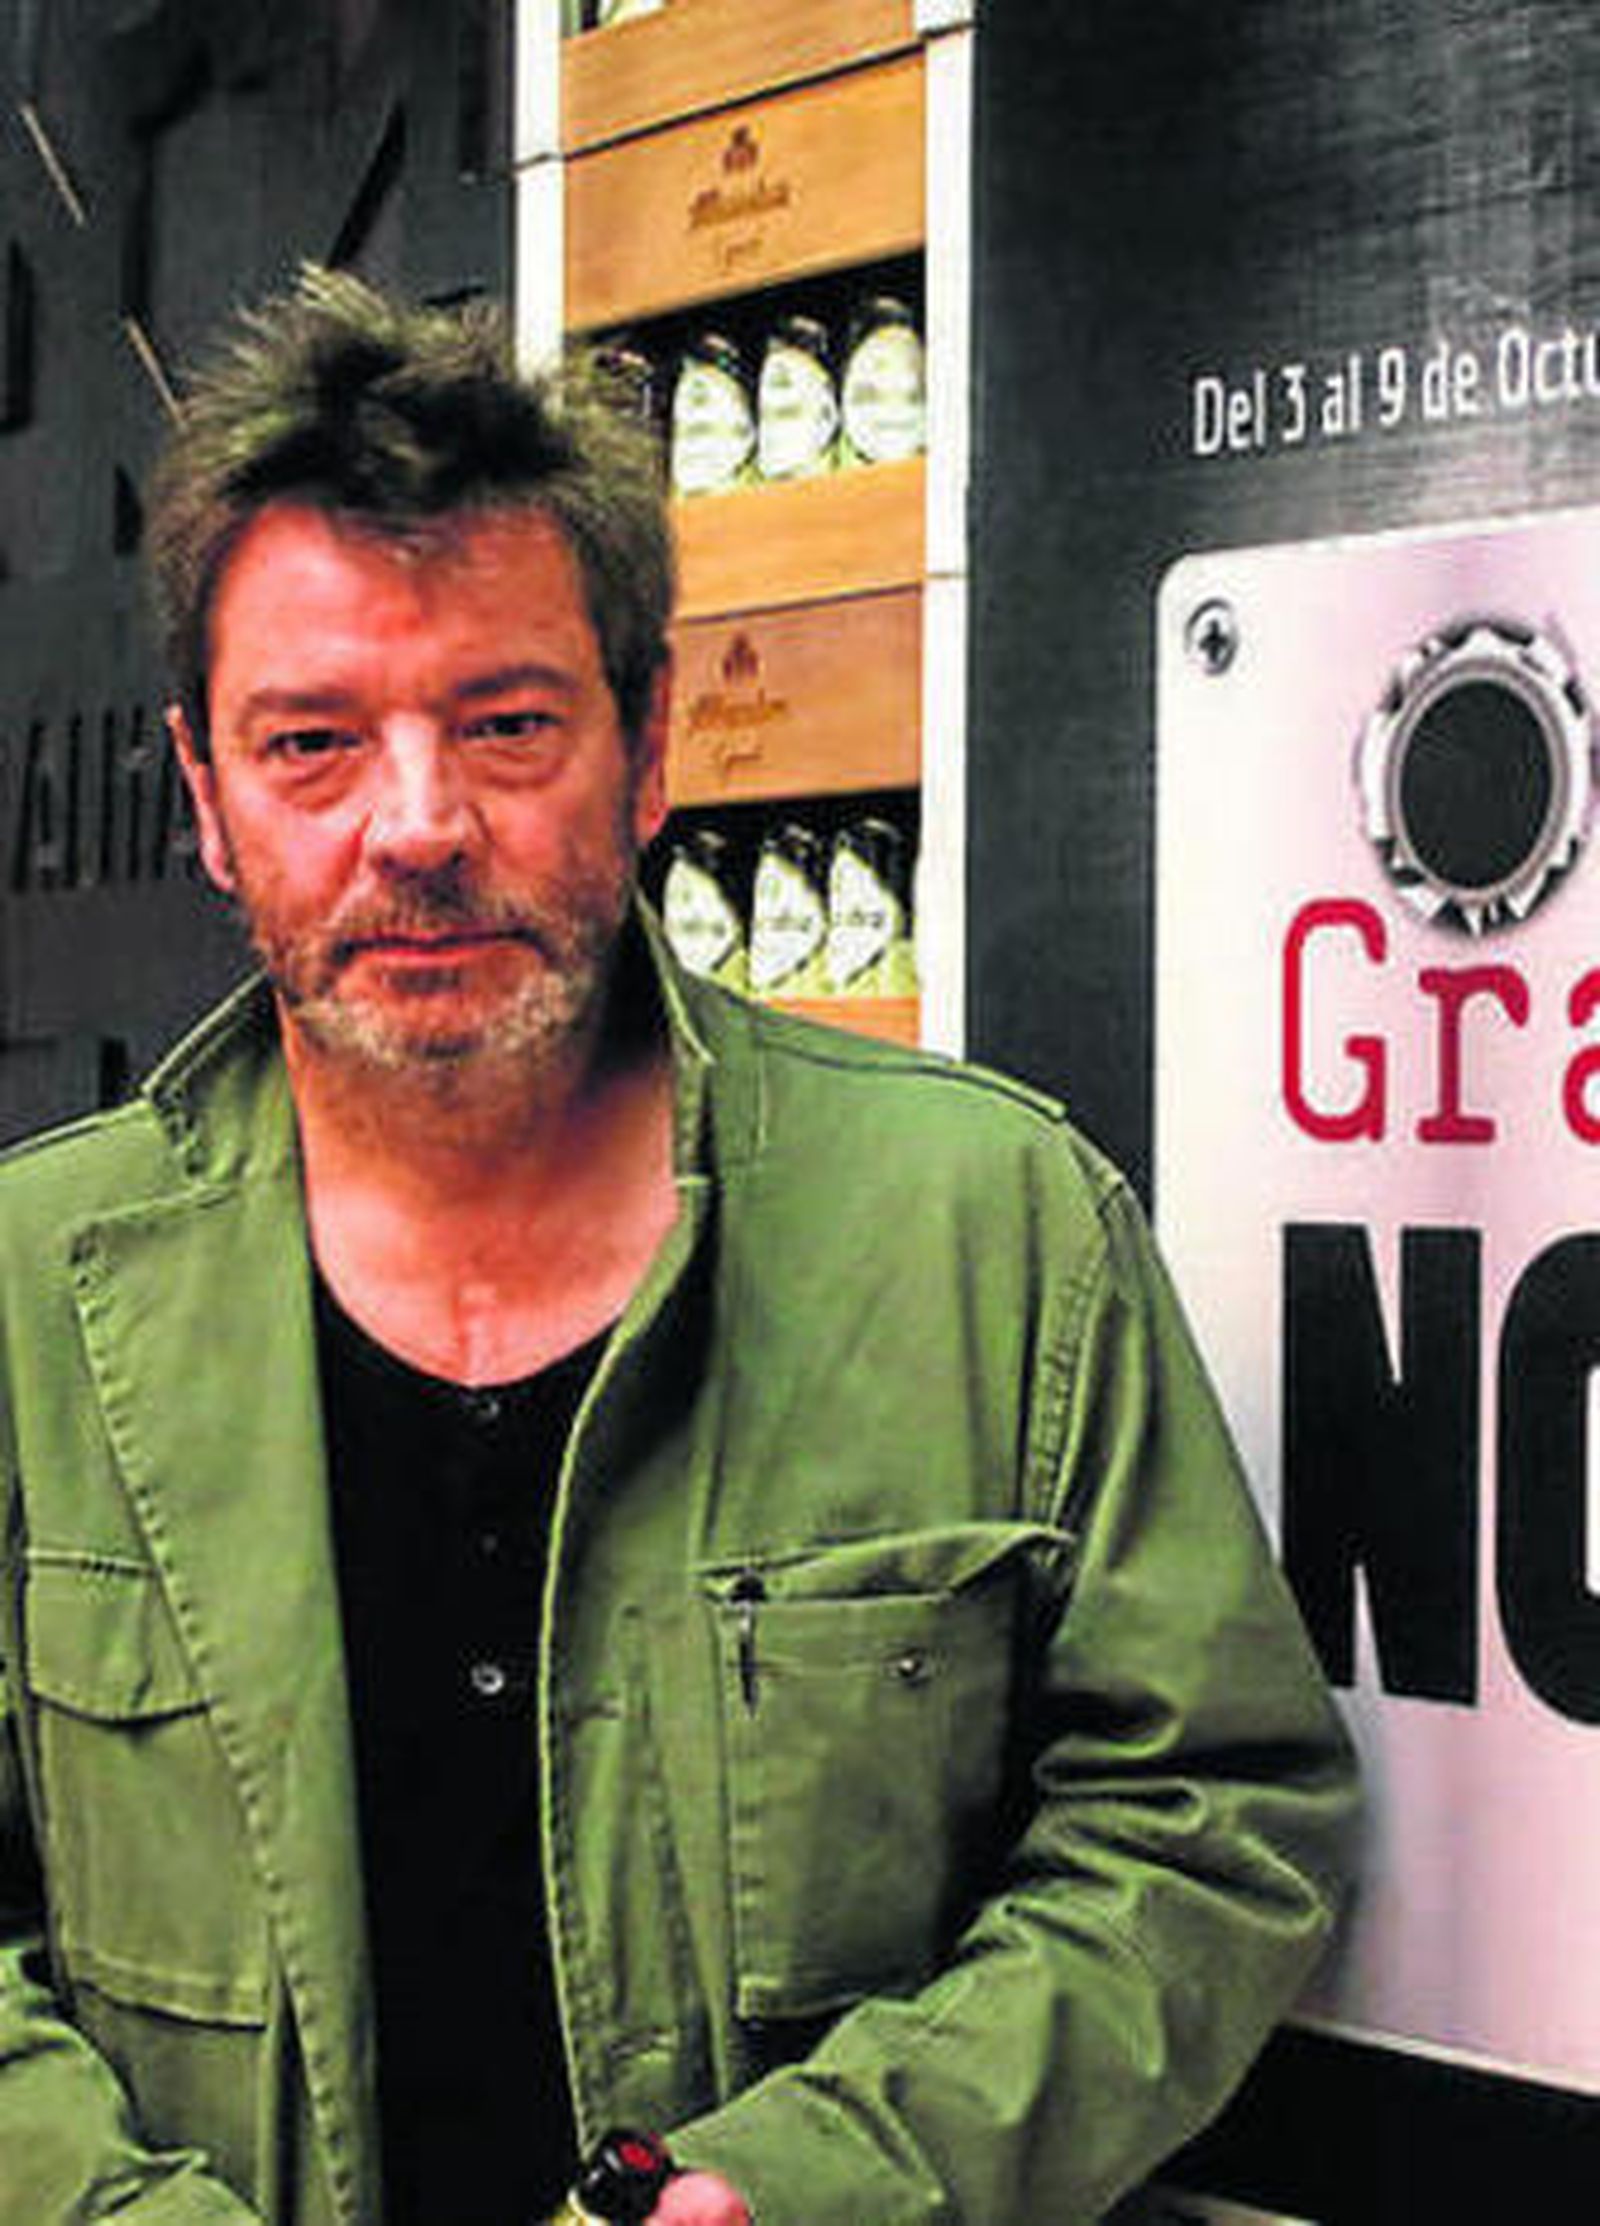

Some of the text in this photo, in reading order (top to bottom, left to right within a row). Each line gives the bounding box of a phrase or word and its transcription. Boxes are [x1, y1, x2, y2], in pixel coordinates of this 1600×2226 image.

[1193, 370, 1266, 455] Del
[1281, 363, 1306, 443] 3
[1321, 353, 1362, 436] al
[1378, 347, 1406, 427] 9
[1422, 339, 1480, 420] de
